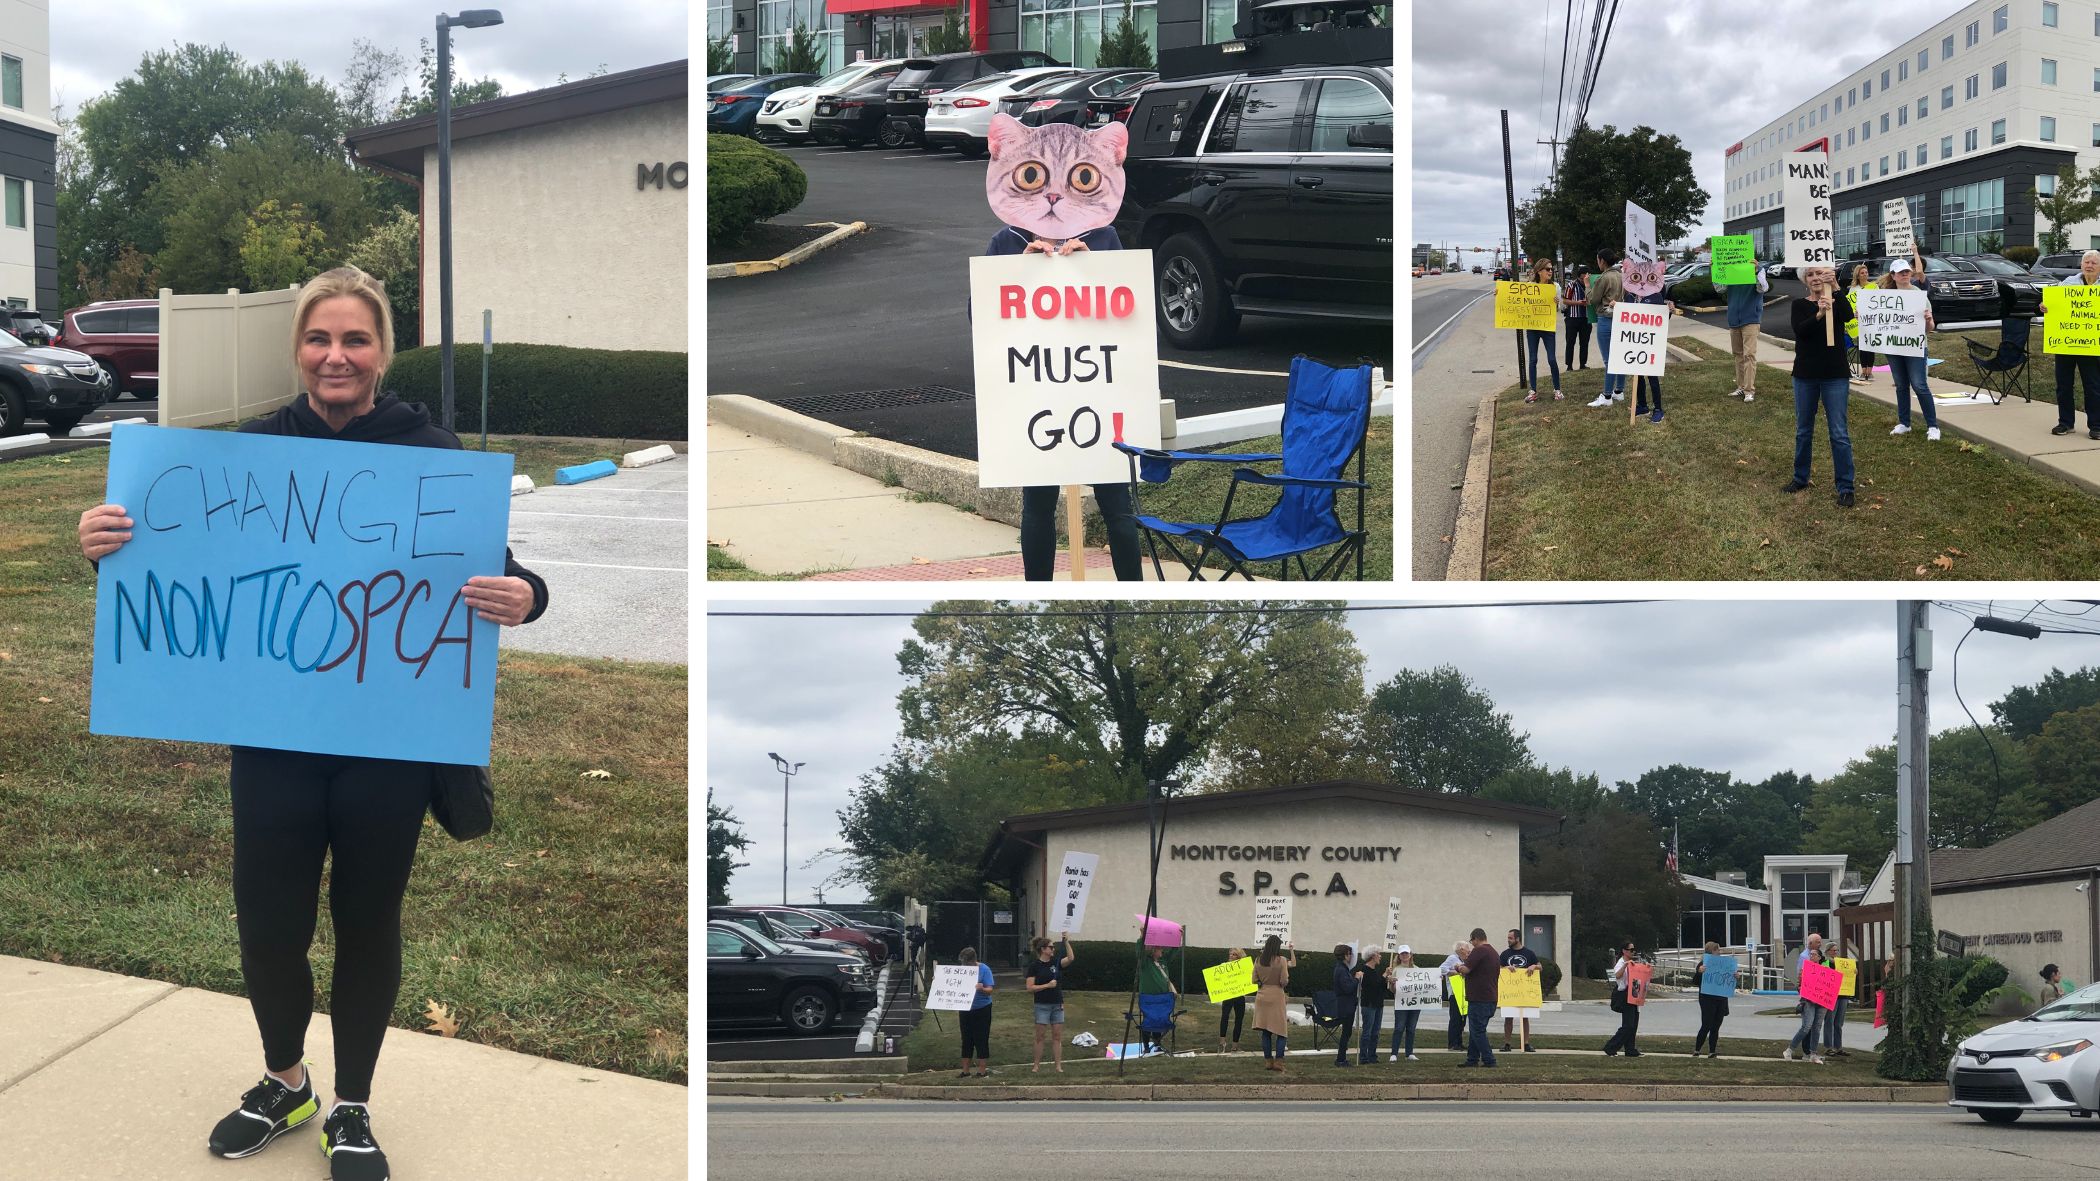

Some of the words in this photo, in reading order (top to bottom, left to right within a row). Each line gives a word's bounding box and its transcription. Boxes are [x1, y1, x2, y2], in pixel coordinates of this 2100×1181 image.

[637, 161, 688, 190] MO
[1508, 283, 1541, 296] SPCA
[2064, 288, 2084, 298] HOW
[1000, 284, 1135, 320] RONIO
[1868, 295, 1904, 311] SPCA
[2071, 300, 2092, 308] MORE
[1620, 311, 1663, 327] RONIO
[1878, 313, 1886, 324] R
[1892, 313, 1915, 324] DOING
[2071, 310, 2100, 319] ANIMAL
[2060, 322, 2080, 330] NEED
[2082, 322, 2093, 330] TO
[1620, 330, 1656, 345] MUST
[1864, 333, 1882, 347] $65
[2064, 336, 2096, 346] Carmen
[1008, 345, 1118, 384] MUST
[1623, 350, 1656, 365] GO!
[144, 464, 475, 559] CHANGE
[1170, 845, 1312, 862] MONTGOMERY
[1321, 846, 1402, 863] COUNTY
[1080, 868, 1090, 877] has
[2034, 930, 2062, 943] CENTER
[1213, 960, 1241, 977] ADOPT
[1405, 972, 1431, 982] SPCA
